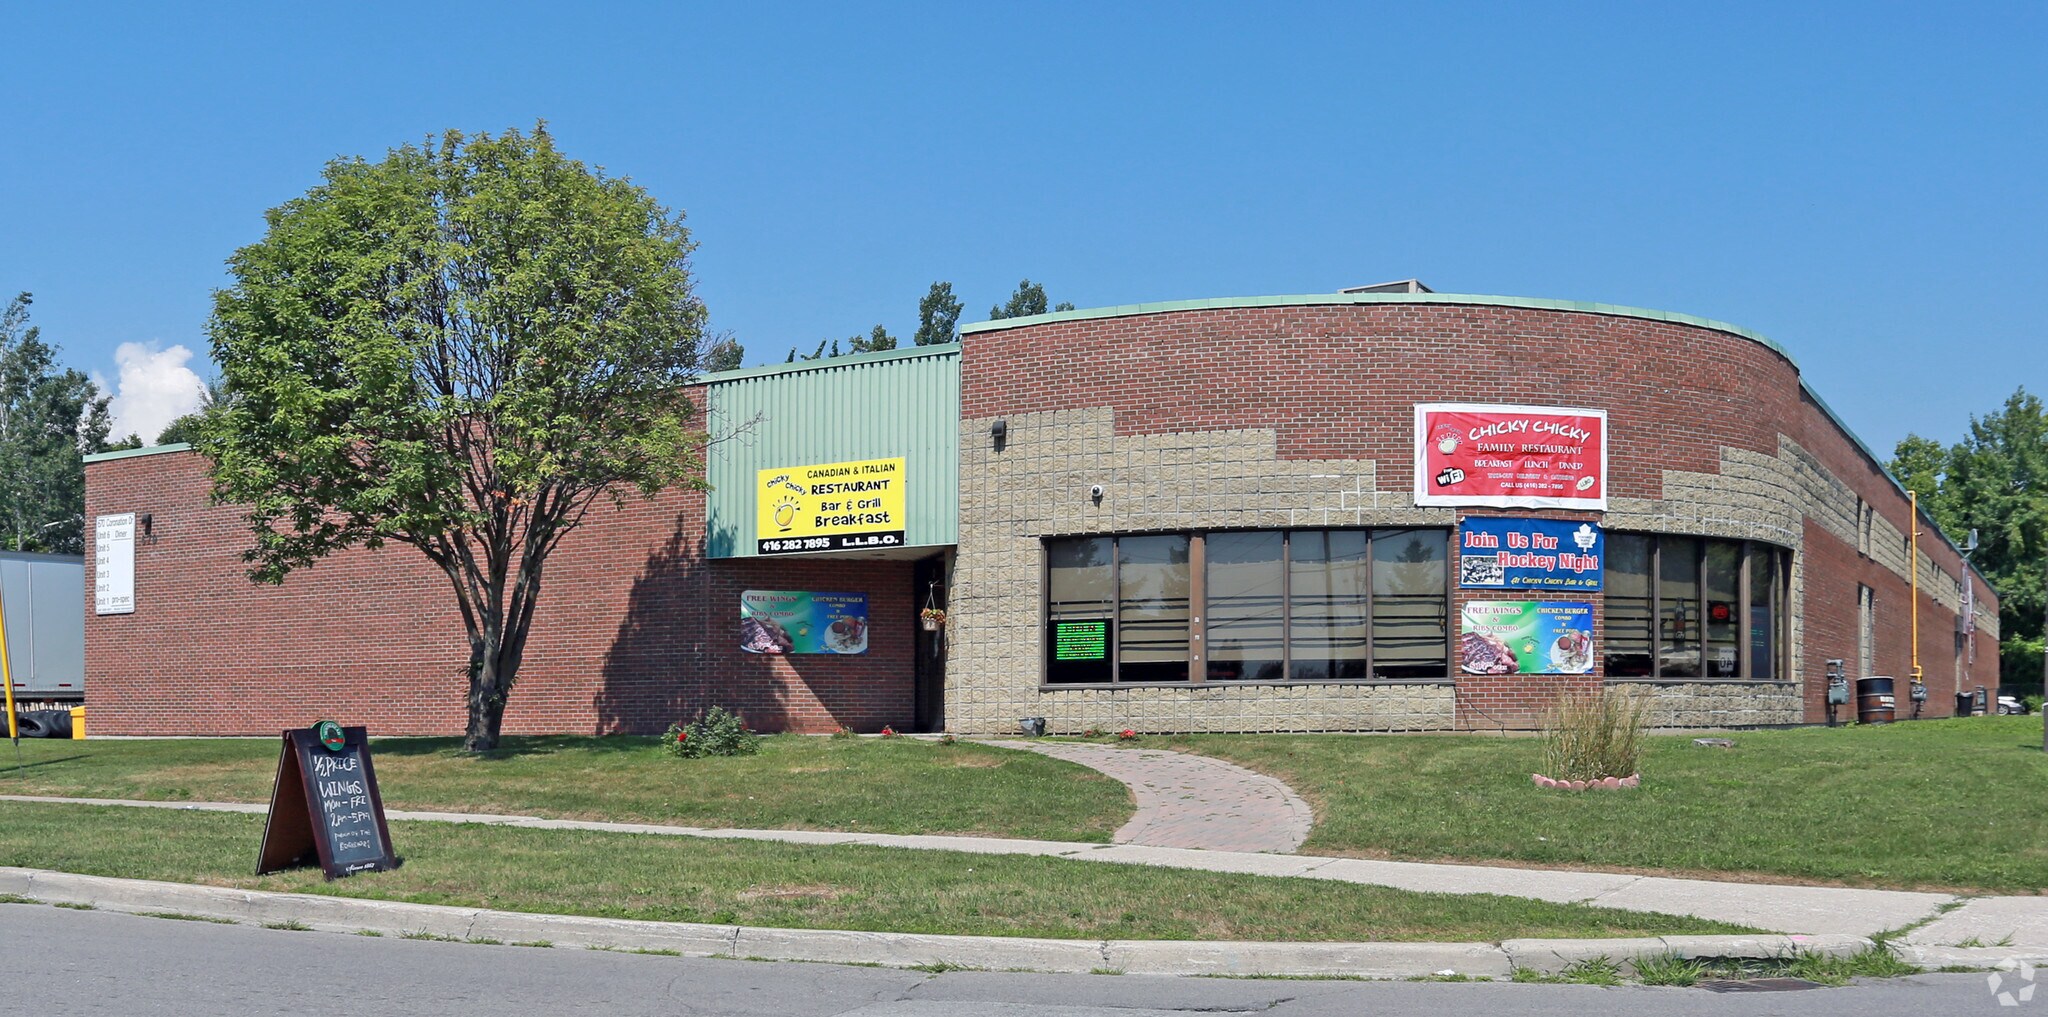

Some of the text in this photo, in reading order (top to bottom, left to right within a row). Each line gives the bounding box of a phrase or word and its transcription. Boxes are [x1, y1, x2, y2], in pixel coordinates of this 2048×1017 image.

[1468, 419, 1529, 441] CHICKY
[1532, 420, 1591, 444] CHICKY
[1477, 443, 1583, 455] FAMILY RESTAURANT
[1474, 459, 1583, 470] BREAKFAST LUNCH DINNER
[807, 463, 896, 479] CANADIAN & ITALIAN
[811, 479, 891, 495] RESTAURANT
[1523, 482, 1538, 490] (416)
[821, 502, 841, 512] Bar
[857, 498, 881, 509] Grill
[106, 518, 127, 527] Coronation
[815, 511, 891, 528] Breakfast
[97, 530, 127, 539] Unit 6 Diner
[1465, 531, 1499, 548] Join
[1507, 532, 1528, 548] Us
[1532, 533, 1558, 549] For
[97, 544, 110, 552] Unit 5
[762, 535, 900, 551] 416 282 7895 L.L.B.O.
[97, 557, 105, 565] Unit
[1497, 551, 1598, 573] Hockey Night
[97, 570, 110, 578] Unit 3
[97, 583, 110, 592] Unit 2
[97, 597, 105, 606] Unit
[1467, 606, 1522, 614] FREE WINGS
[1537, 607, 1563, 615] CHICKEN
[325, 756, 358, 777] PRICE
[319, 780, 362, 798] WINGS
[324, 799, 340, 813] MON
[350, 795, 366, 809] FRI
